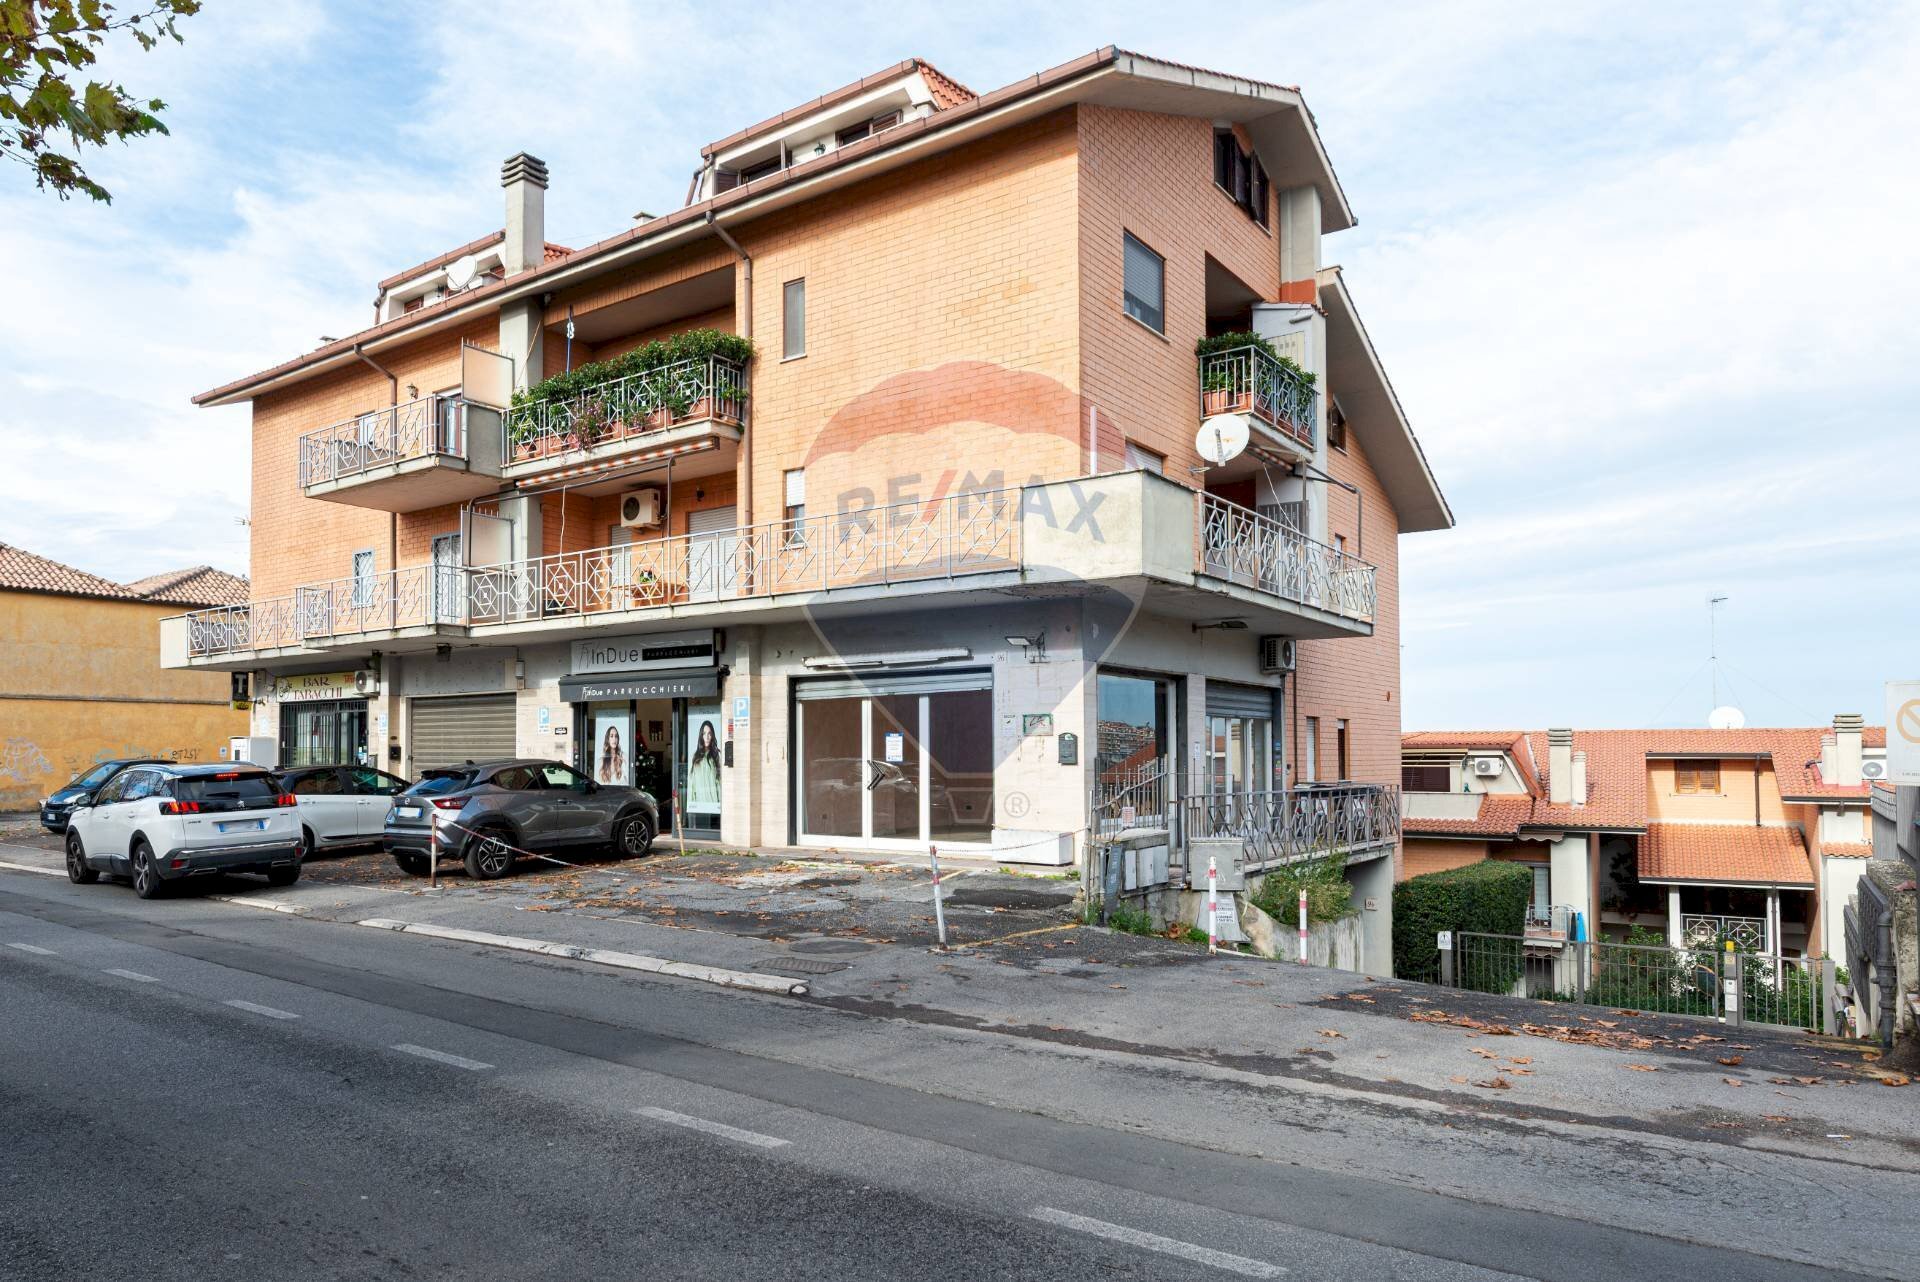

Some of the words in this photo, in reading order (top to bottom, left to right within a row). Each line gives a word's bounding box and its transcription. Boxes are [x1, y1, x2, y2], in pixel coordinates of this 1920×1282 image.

[303, 676, 331, 688] BAR
[294, 687, 343, 700] TABACCHI
[606, 685, 691, 695] PARRUCCHIERI
